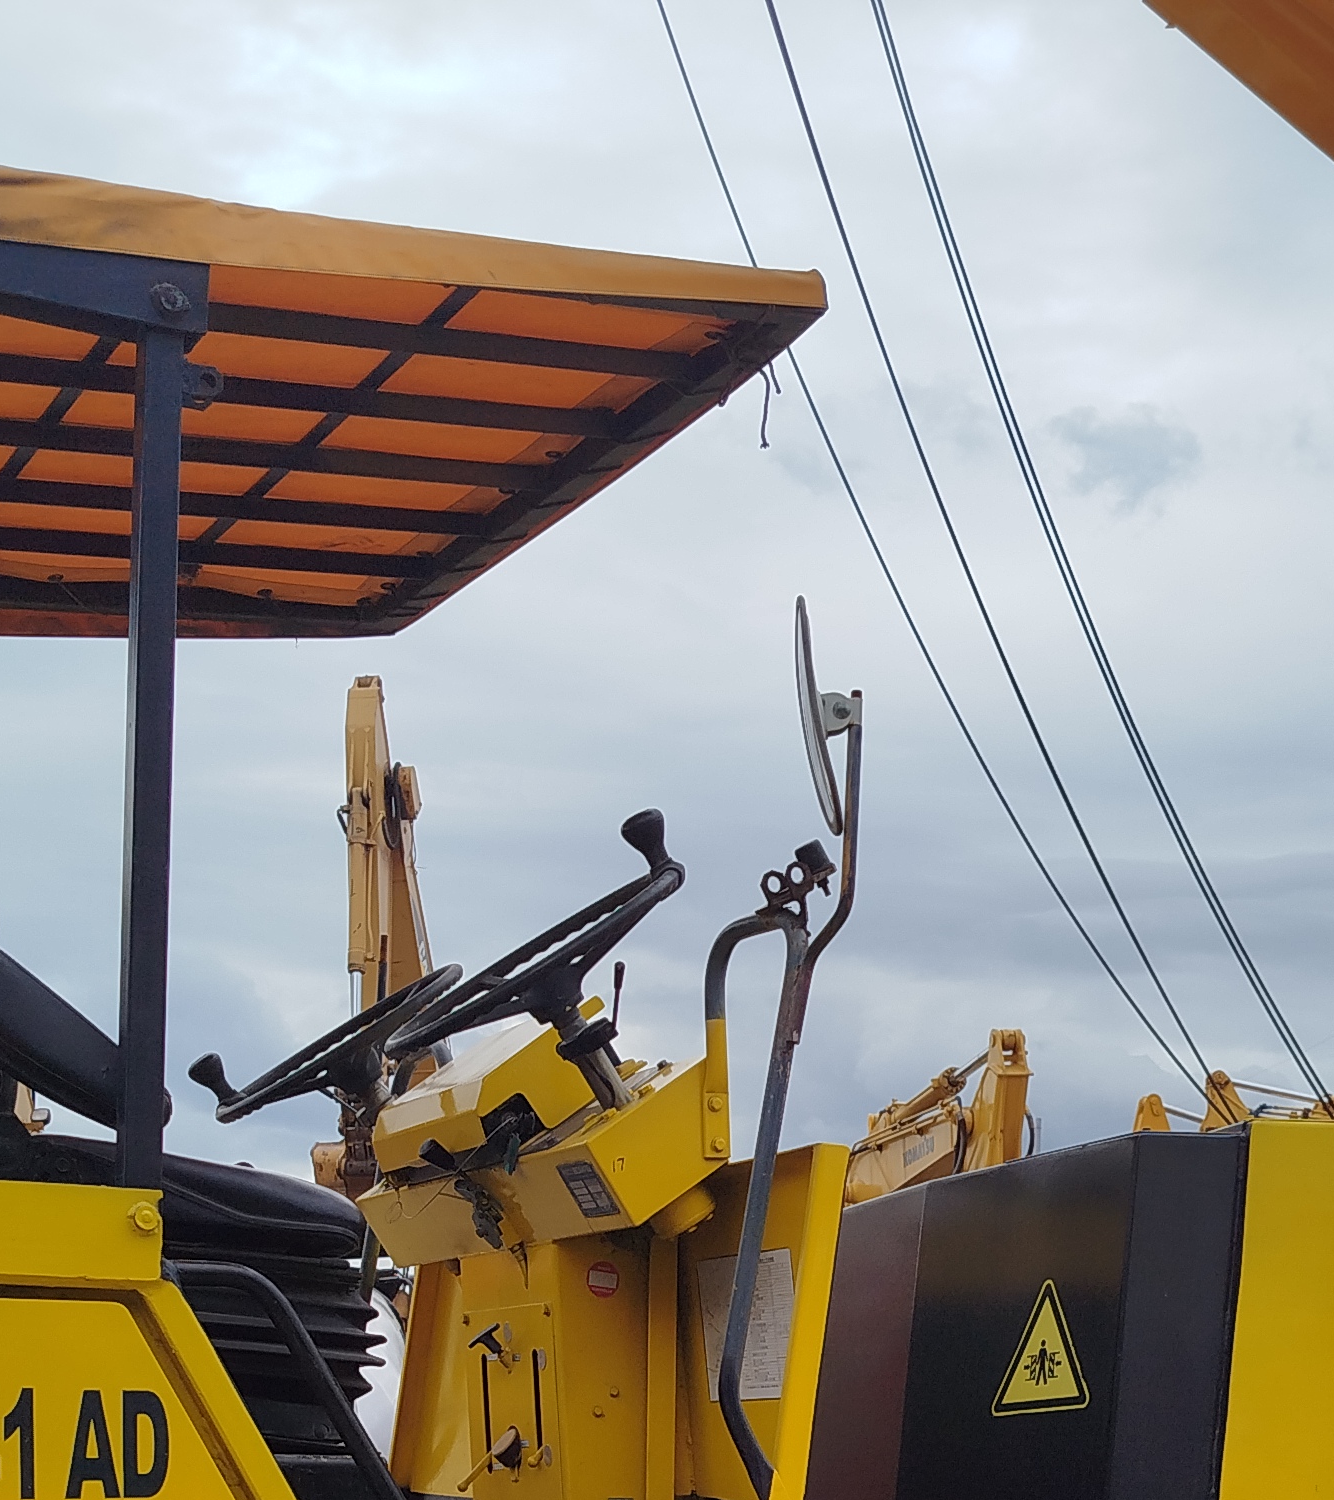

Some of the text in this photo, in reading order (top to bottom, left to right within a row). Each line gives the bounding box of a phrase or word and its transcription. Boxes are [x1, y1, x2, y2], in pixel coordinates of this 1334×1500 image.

[612, 1157, 625, 1173] 17
[903, 1135, 934, 1168] KOMATSU
[65, 1389, 168, 1499] AD
